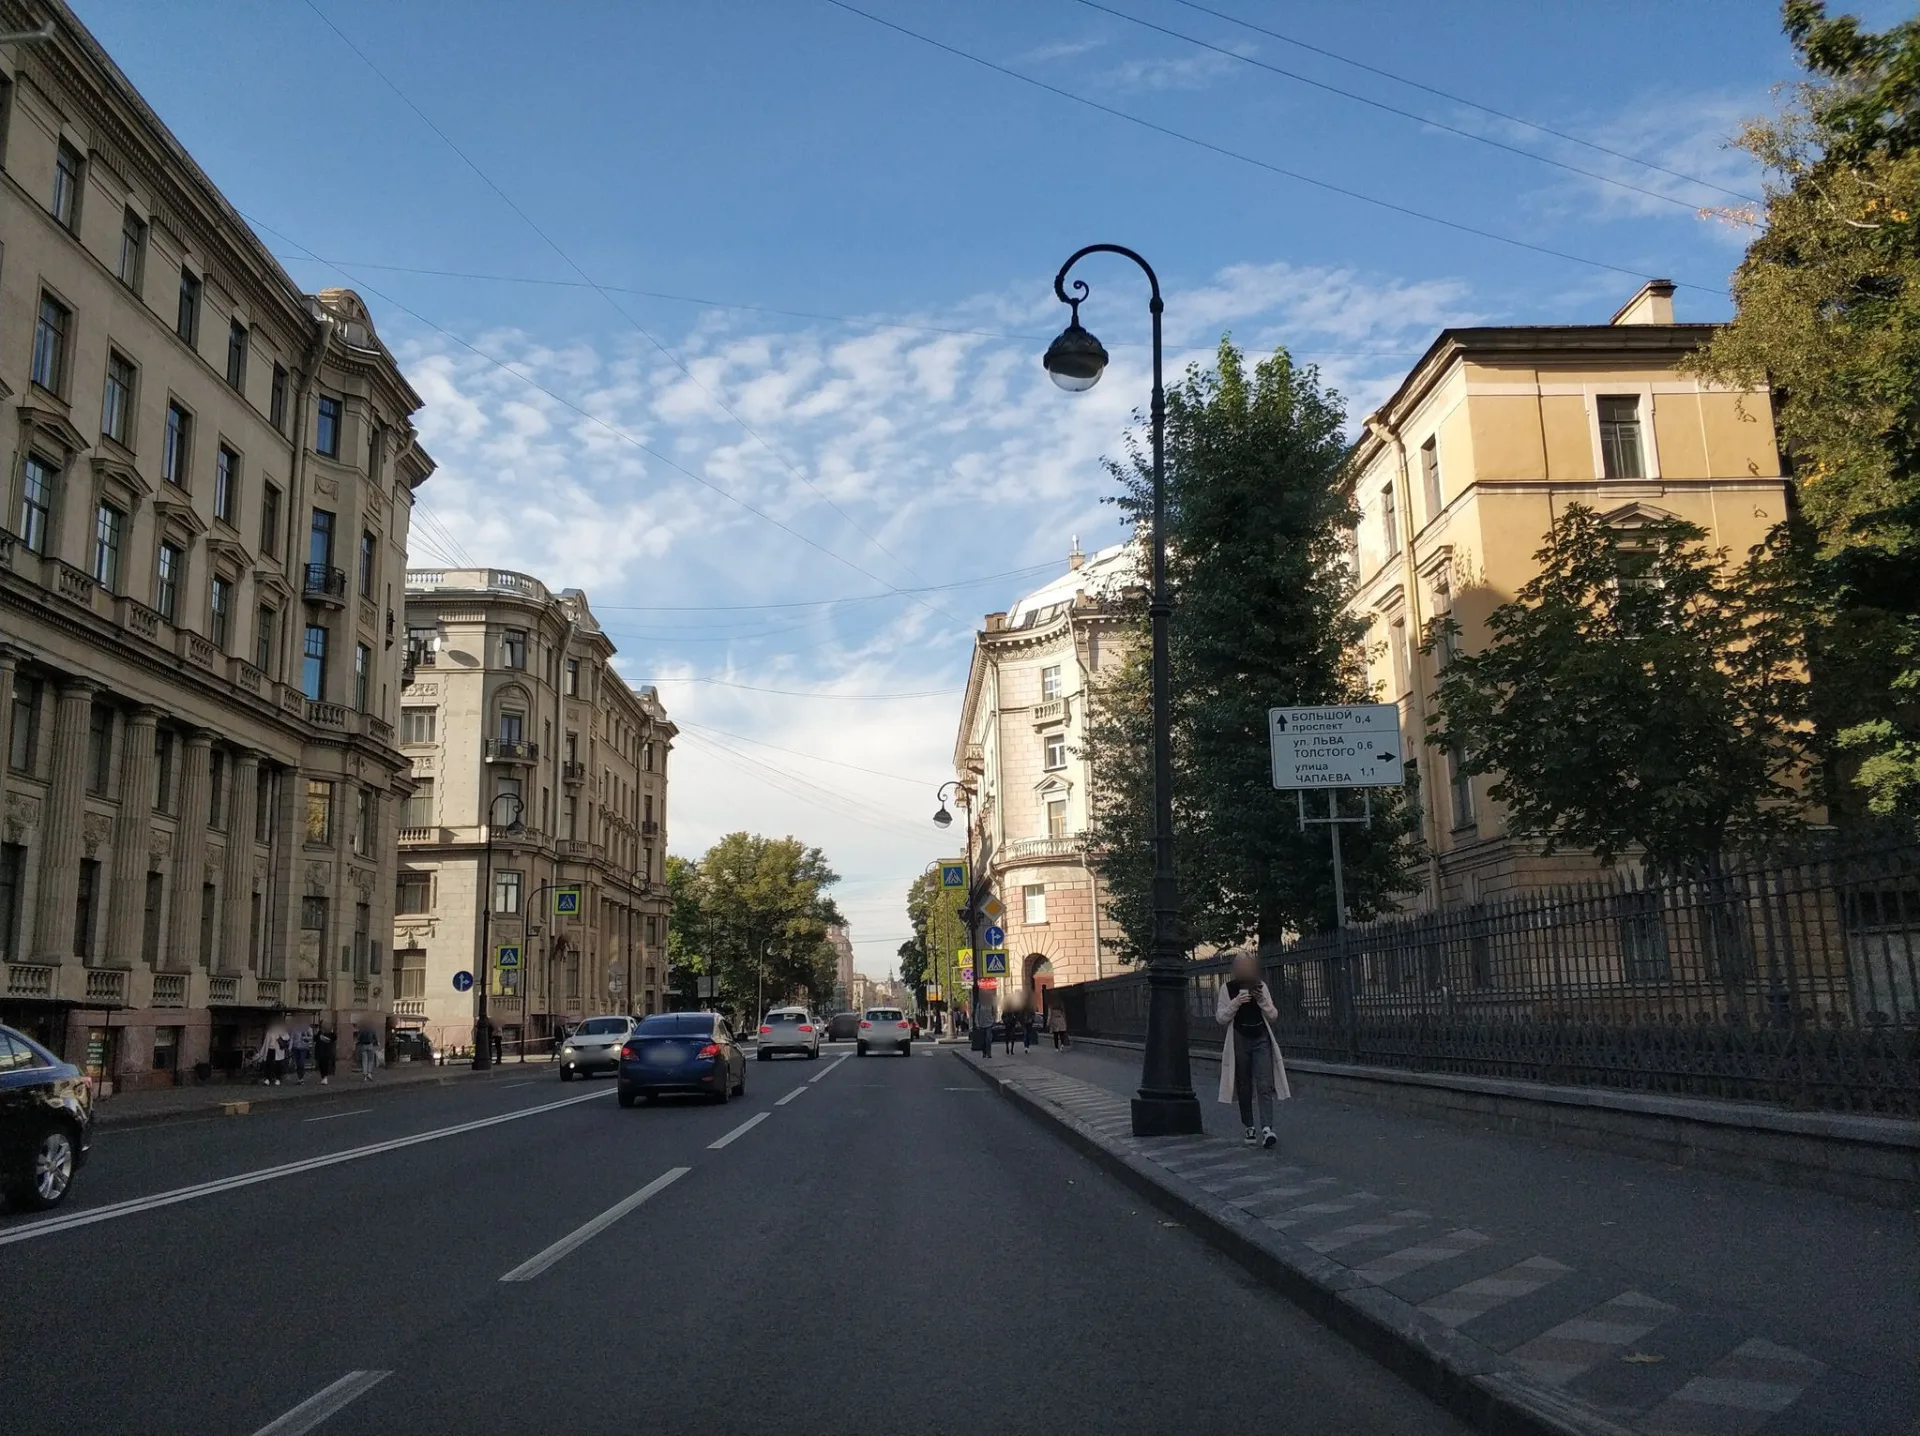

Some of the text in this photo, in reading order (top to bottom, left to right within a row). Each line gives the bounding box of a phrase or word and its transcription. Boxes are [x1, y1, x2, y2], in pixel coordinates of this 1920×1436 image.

[1292, 710, 1352, 722] БОЛЬШОЙ
[1355, 715, 1371, 725] 0,4
[1292, 723, 1343, 733] проспект
[1293, 736, 1345, 748] ул. ЛЬВА
[1357, 741, 1373, 751] 0,6
[1294, 748, 1356, 758] ТОЛСТОГО
[1295, 763, 1329, 773] улица
[1295, 773, 1352, 783] ЧАПАЕВА
